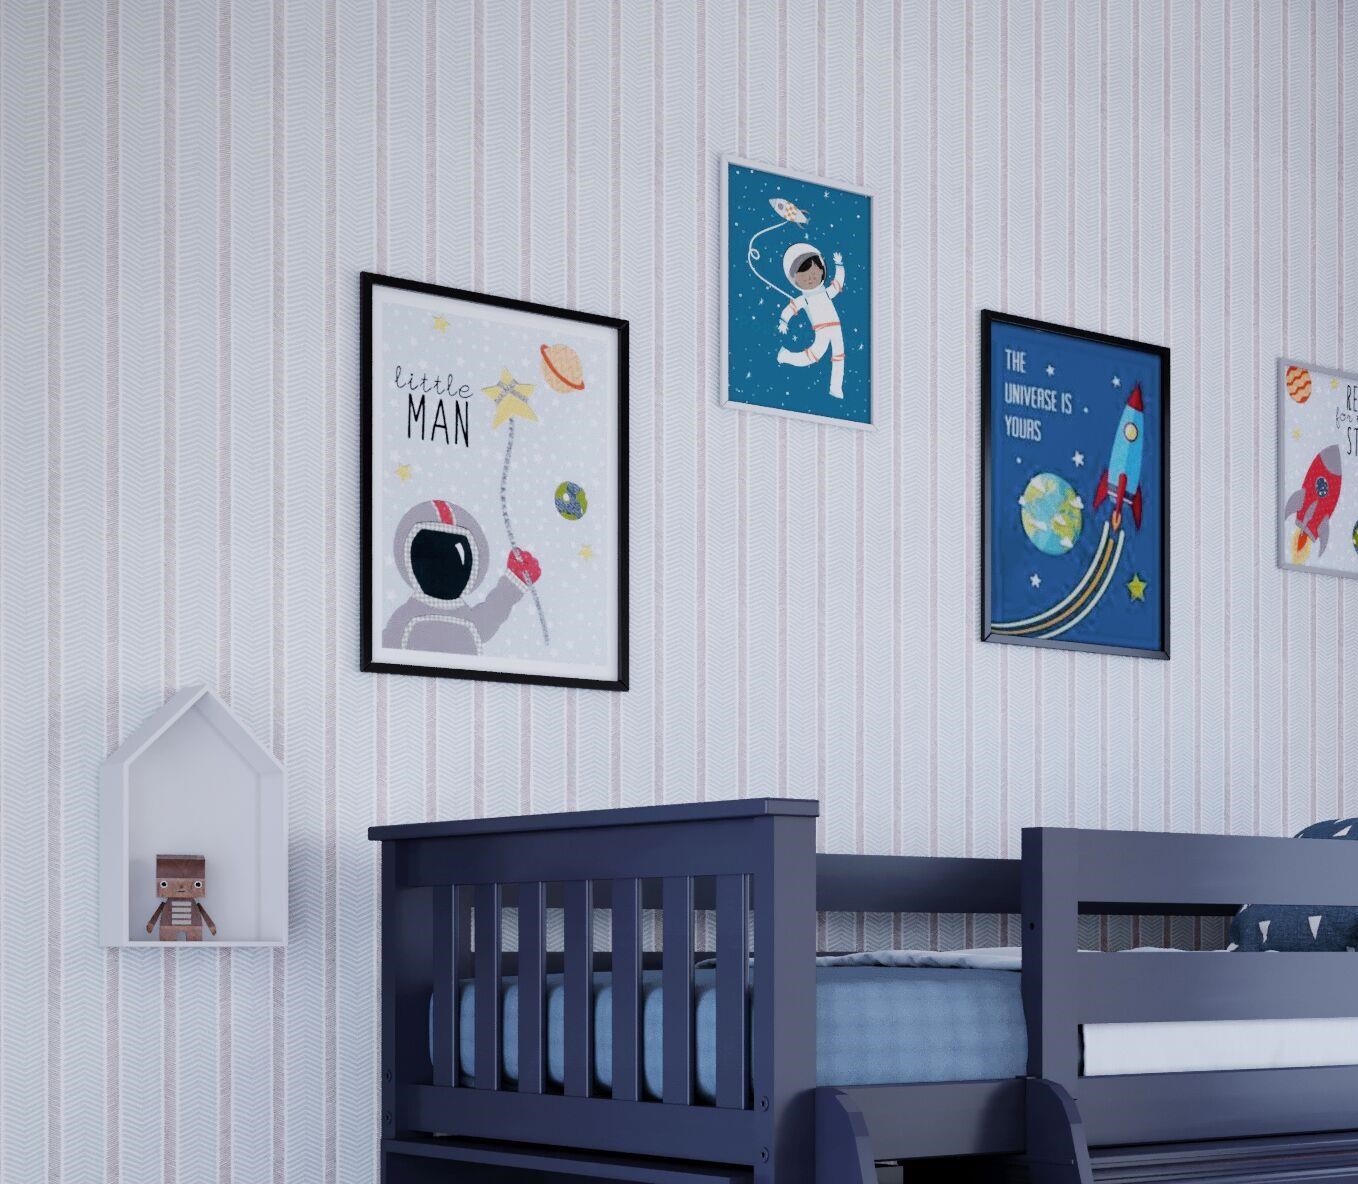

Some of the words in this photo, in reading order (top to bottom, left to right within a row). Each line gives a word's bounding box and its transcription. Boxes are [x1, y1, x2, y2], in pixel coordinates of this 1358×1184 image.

[1004, 348, 1027, 374] THE
[394, 365, 474, 399] little
[1004, 383, 1058, 413] UNIVERSE
[1061, 392, 1073, 415] IS
[407, 393, 469, 448] MAN
[1004, 414, 1042, 443] YOURS
[1335, 406, 1354, 430] for
